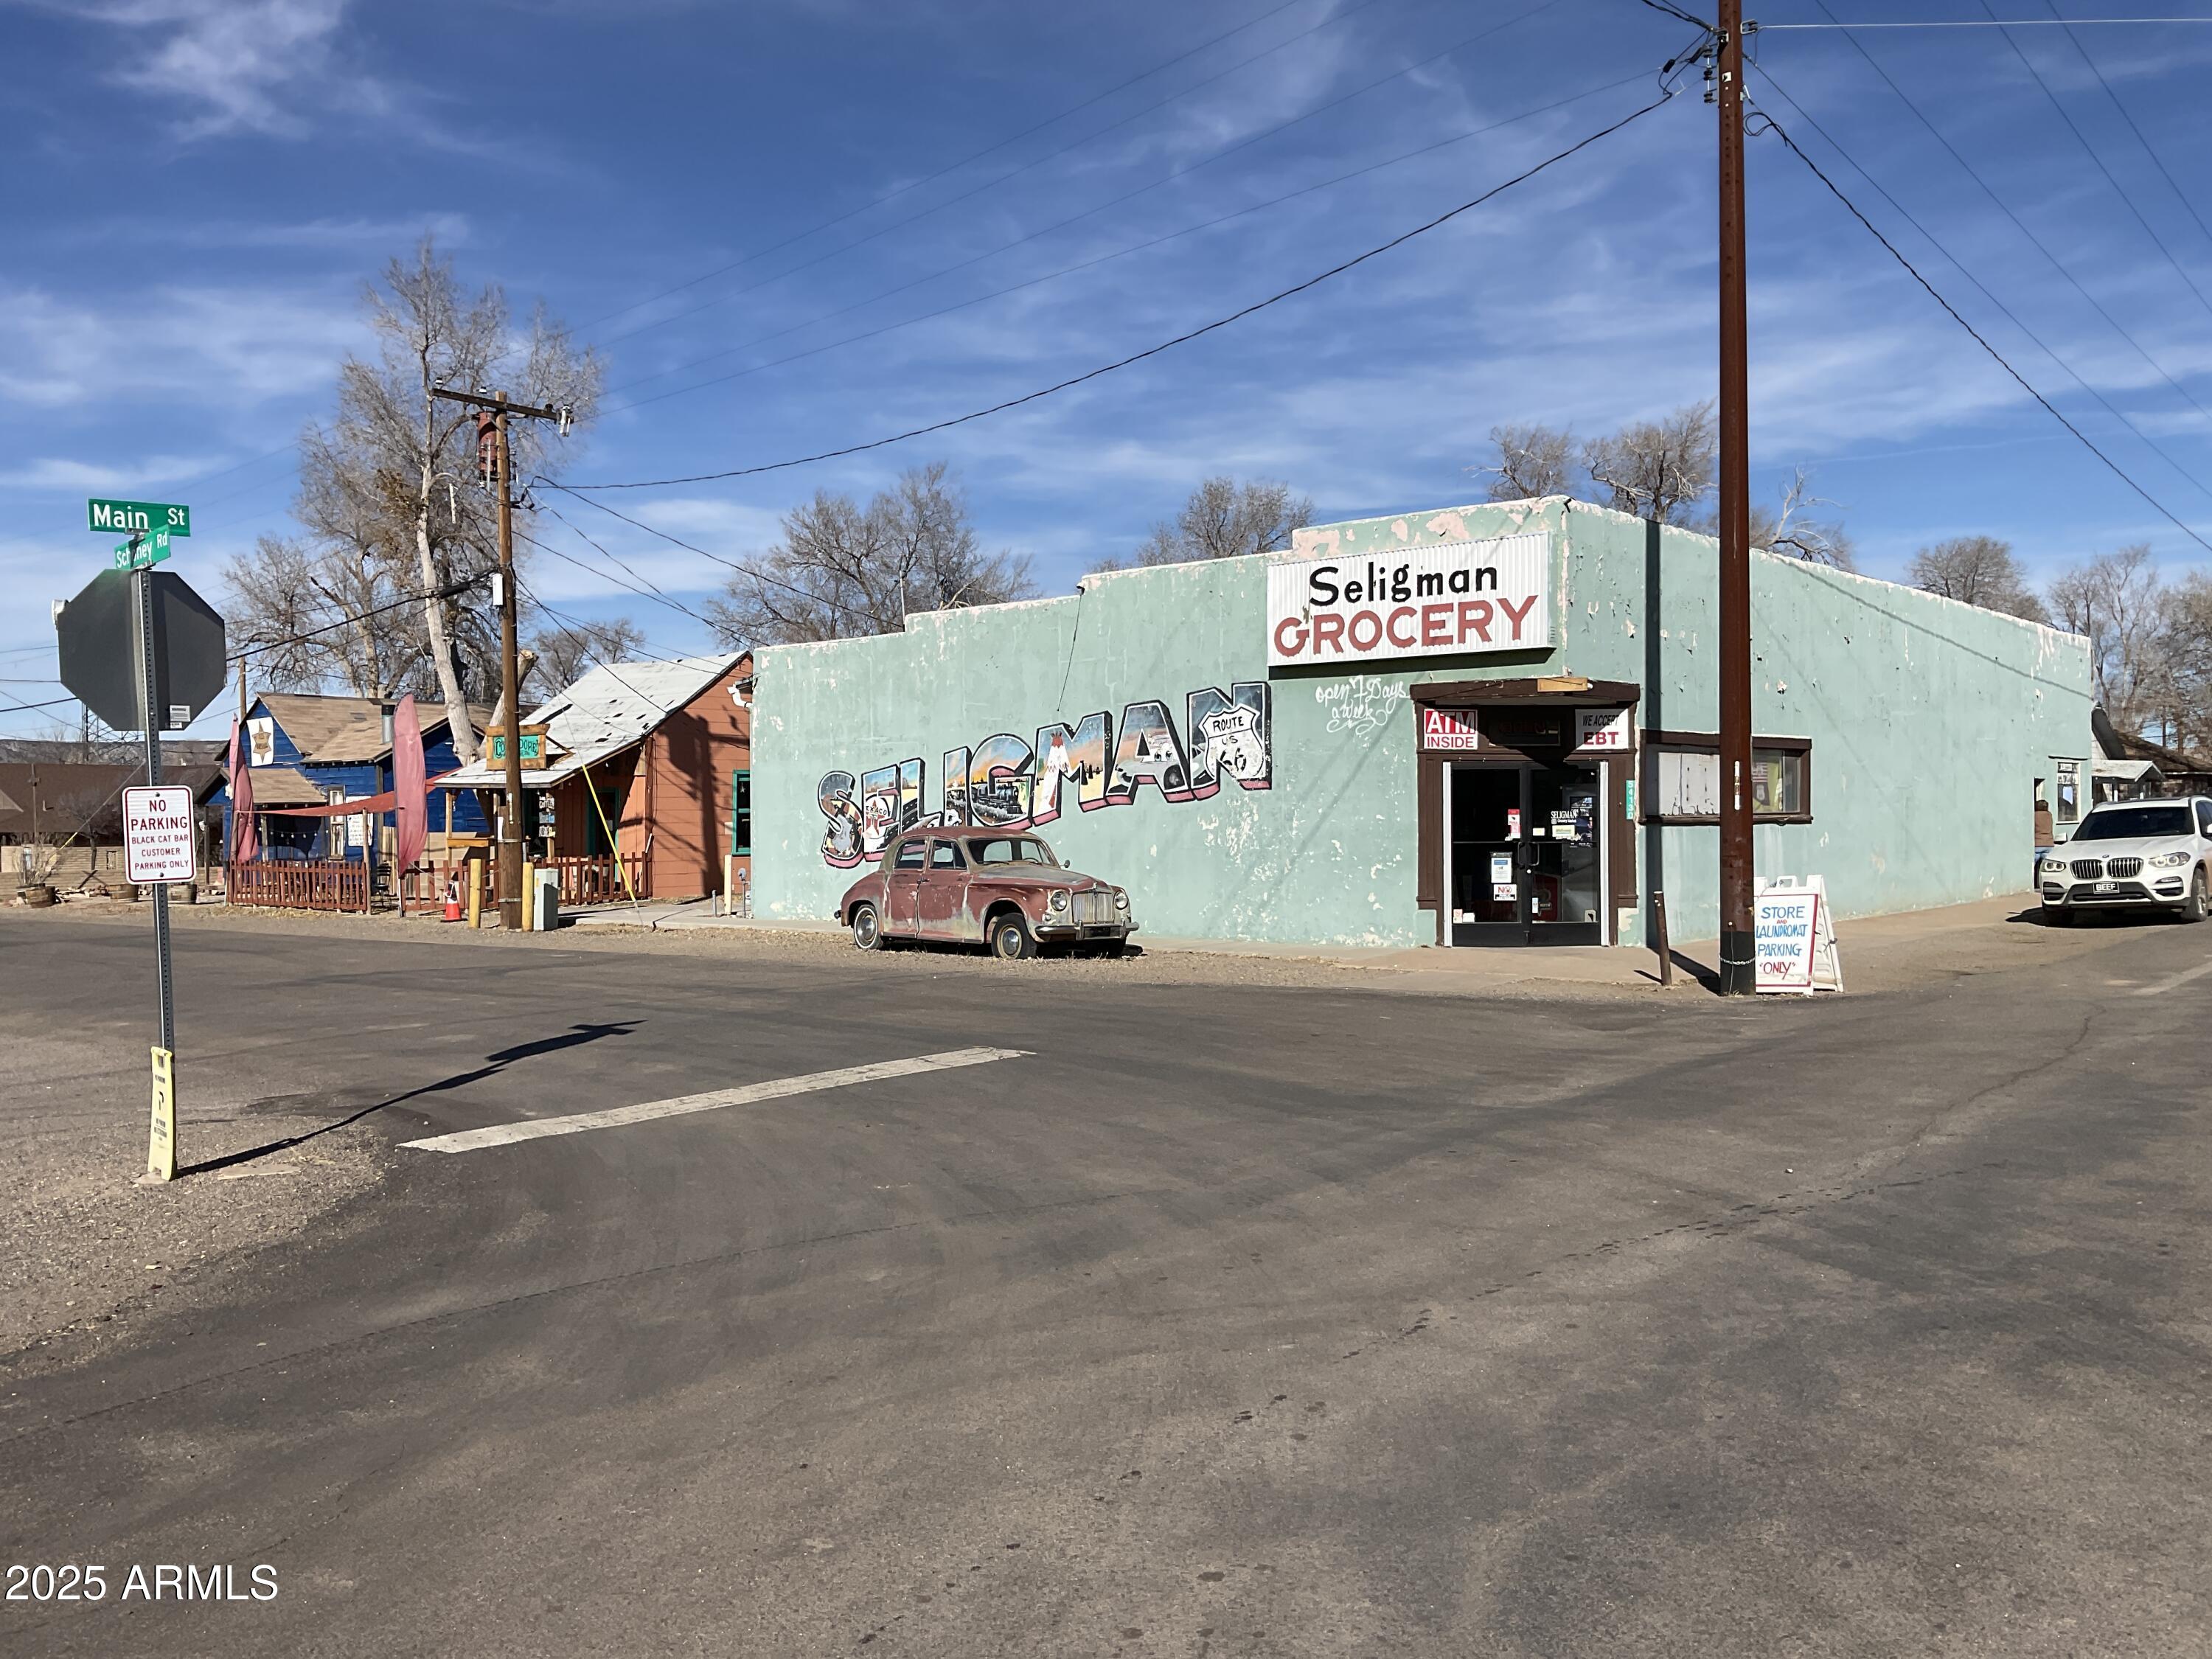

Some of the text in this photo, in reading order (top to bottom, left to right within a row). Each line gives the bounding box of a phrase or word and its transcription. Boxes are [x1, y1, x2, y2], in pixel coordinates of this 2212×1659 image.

[93, 504, 185, 529] Main St
[116, 531, 168, 568] Schney Rd
[1309, 562, 1498, 606] Seligman
[1273, 594, 1538, 657] GROCERY
[1365, 678, 1411, 714] Days
[1213, 717, 1244, 732] ROUTE
[1427, 711, 1475, 734] ATM
[1583, 714, 1620, 726] WE ACCEPT
[1222, 735, 1239, 745] US
[1427, 736, 1474, 748] INSIDE
[1583, 731, 1619, 745] EBT
[817, 681, 1272, 869] SELIGMAN
[149, 799, 167, 812] NO
[1551, 810, 1577, 819] SELIGMAN
[131, 816, 188, 831] PARKING
[131, 834, 188, 844] BLACK CAT BAR
[142, 847, 181, 857] CUSTOMER
[135, 860, 189, 870] PARKING ONLY
[1761, 905, 1805, 919] STORE
[1756, 924, 1808, 939] LAUNDROMAT
[1758, 943, 1802, 957] PARKING
